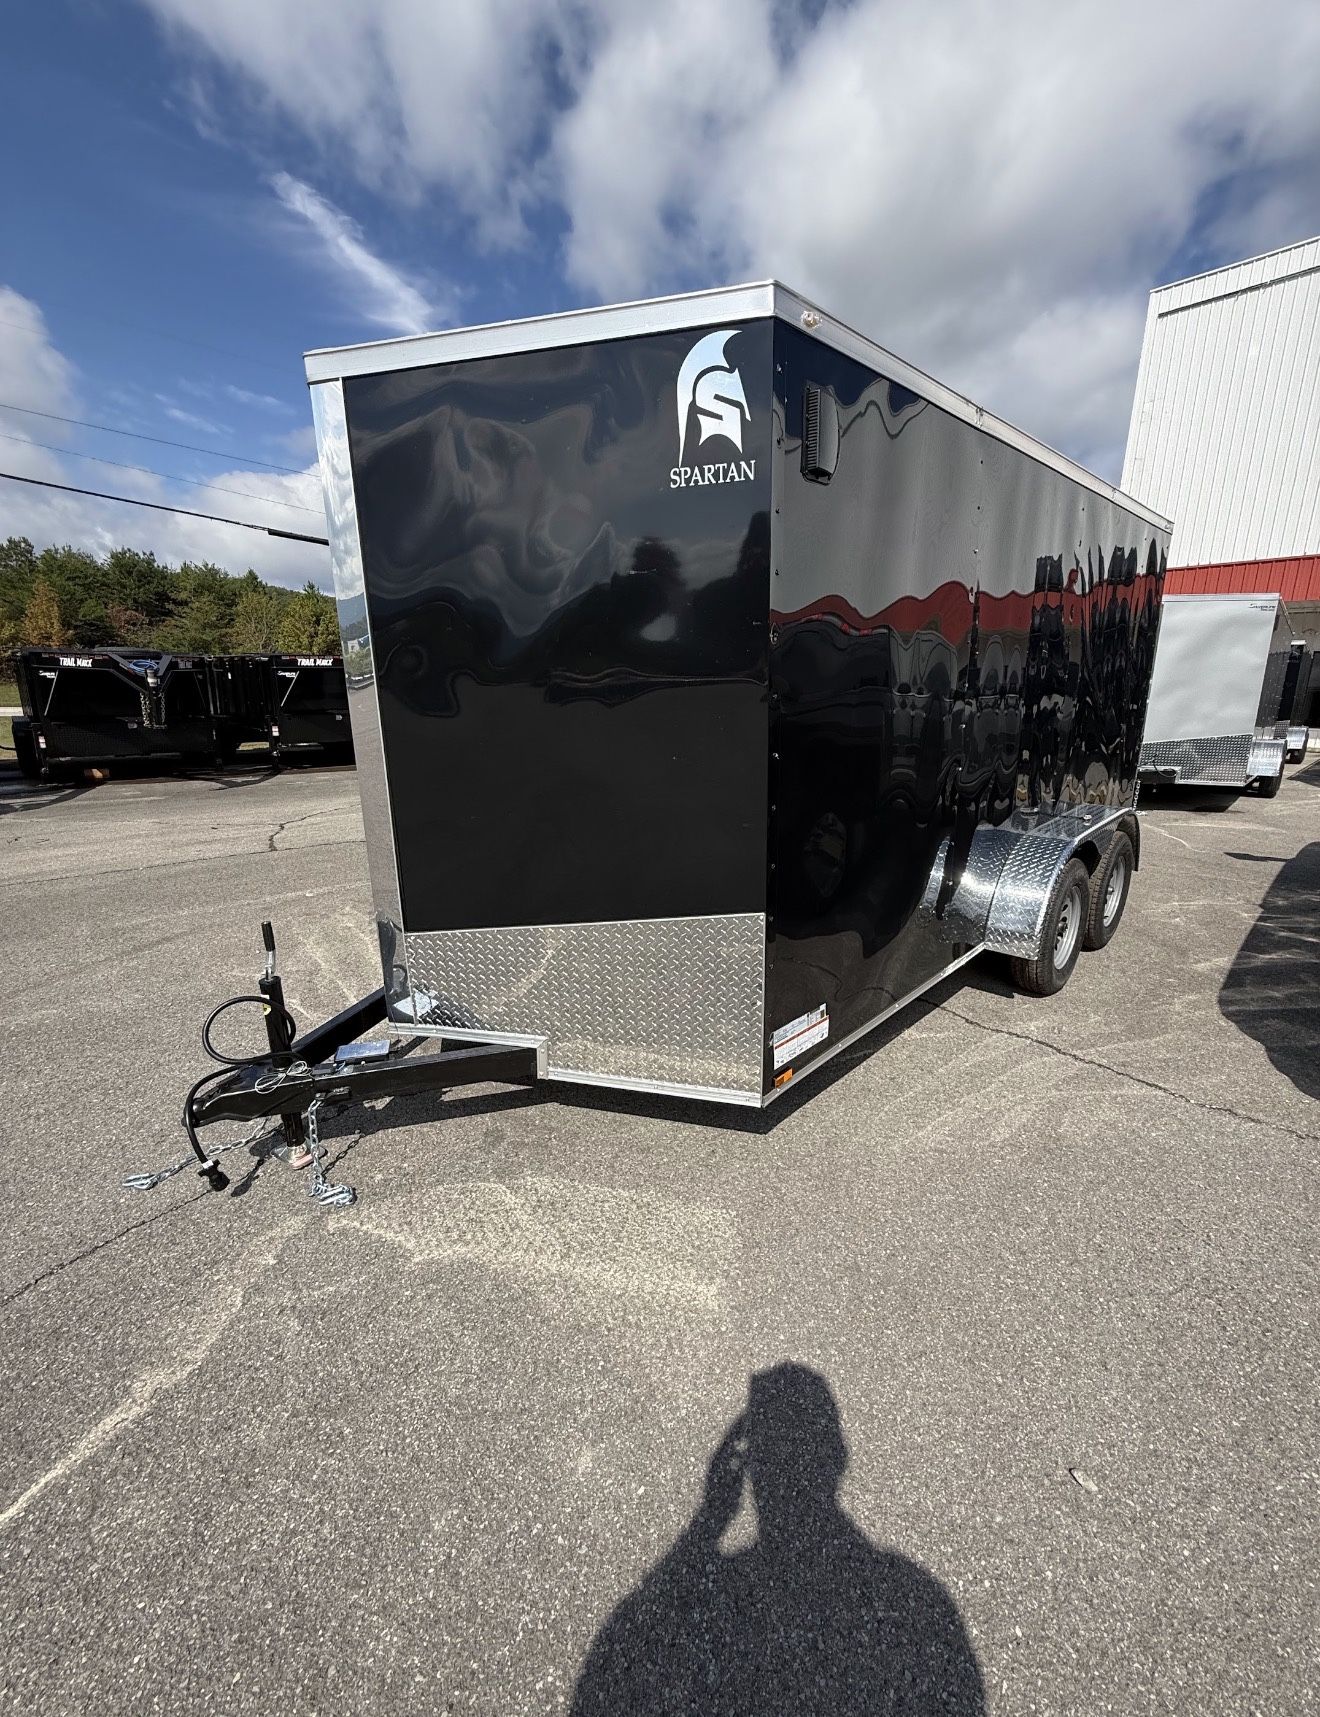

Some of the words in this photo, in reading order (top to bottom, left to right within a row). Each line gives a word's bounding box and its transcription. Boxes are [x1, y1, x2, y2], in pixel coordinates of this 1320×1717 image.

[669, 460, 757, 489] SPARTAN
[59, 657, 76, 667] TRAIL
[297, 658, 315, 667] TRAIL
